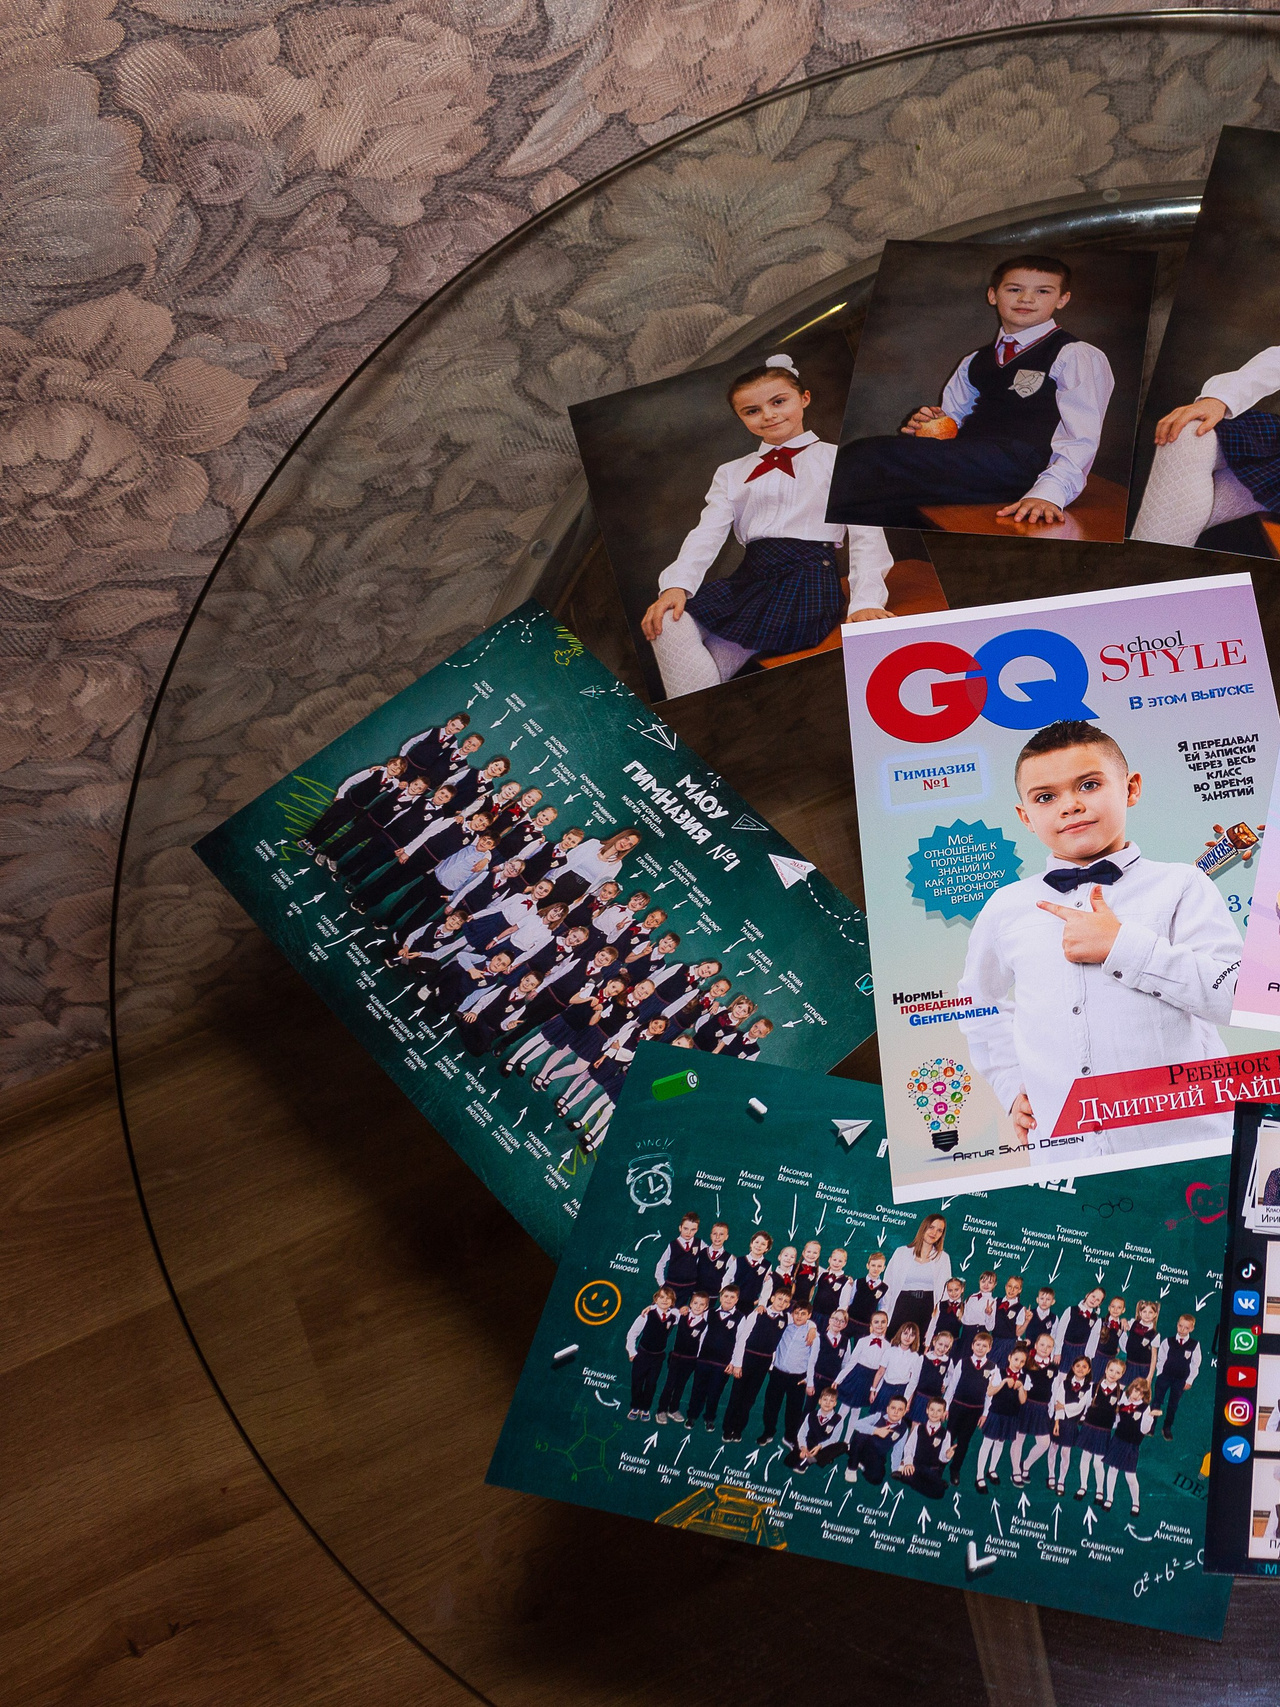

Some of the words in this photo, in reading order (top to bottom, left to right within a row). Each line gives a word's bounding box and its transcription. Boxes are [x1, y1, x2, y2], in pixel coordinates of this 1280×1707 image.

[1100, 639, 1247, 682] STYLE
[866, 629, 1100, 743] GQ
[1129, 696, 1143, 710] В
[1148, 693, 1187, 707] ЭТОМ
[1191, 684, 1254, 701] ВЫПУСКЕ
[1178, 741, 1188, 752] Я
[1193, 734, 1259, 750] ПЕРЕДАВАЛ
[1185, 751, 1199, 762] ЕЙ
[1205, 745, 1256, 759] ЗАПИСКИ
[1188, 760, 1222, 772] ЧЕРЕЗ
[1227, 756, 1256, 767] ВЕСЬ
[1206, 767, 1241, 780] КЛАСС
[1194, 782, 1210, 792] ВО
[1215, 777, 1254, 790] ВРЕМЯ
[676, 774, 729, 819] МАОУ
[1201, 786, 1254, 801] ЗАНЯТИЙ
[623, 760, 712, 845] ГИМНАЗИЯ
[924, 843, 987, 859] ОТНОШЕНИЕ
[931, 852, 995, 867] ПОЛУЧЕНИЮ
[1198, 838, 1233, 872] SNICKERS
[938, 864, 979, 876] ЗНАНИЙ
[925, 879, 944, 888] КАК
[956, 870, 1005, 884] ПРОВОЖУ
[934, 881, 999, 897] ВНЕУРОЧНОЕ
[951, 892, 984, 904] ВРЕМЯ
[1228, 895, 1241, 912] 3
[1212, 960, 1241, 989] ВОЗРАСТ
[901, 996, 972, 1014] ПОВЕДЕНИЯ
[1172, 1472, 1208, 1501] IDE
